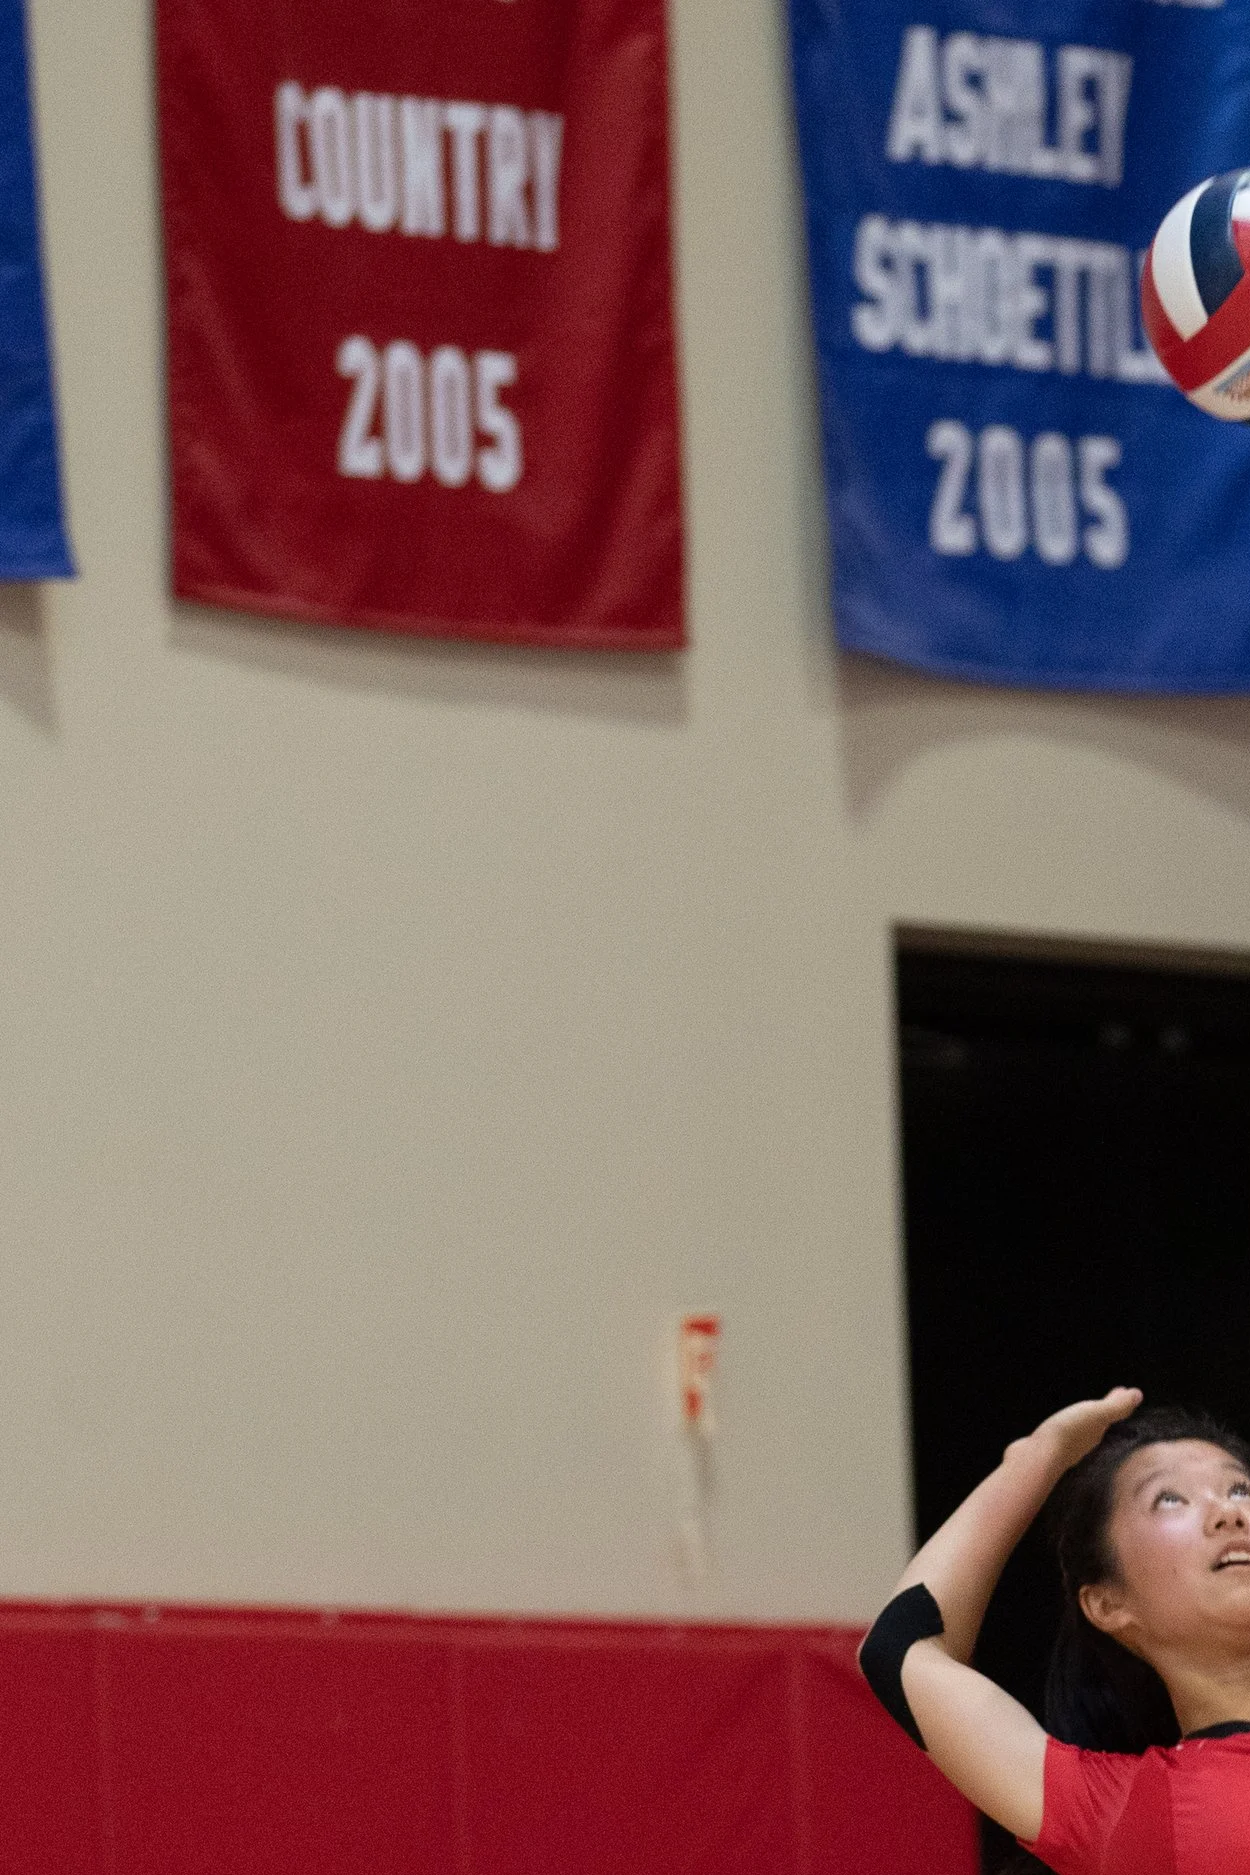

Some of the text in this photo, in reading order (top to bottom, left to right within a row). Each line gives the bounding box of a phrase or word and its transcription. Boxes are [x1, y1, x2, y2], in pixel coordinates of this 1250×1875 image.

[274, 80, 564, 252] COUNTRY
[886, 24, 1135, 188] ASHLEY
[851, 213, 1178, 387] SCHOETTL
[335, 334, 521, 493] 2005
[925, 417, 1130, 570] 2005
